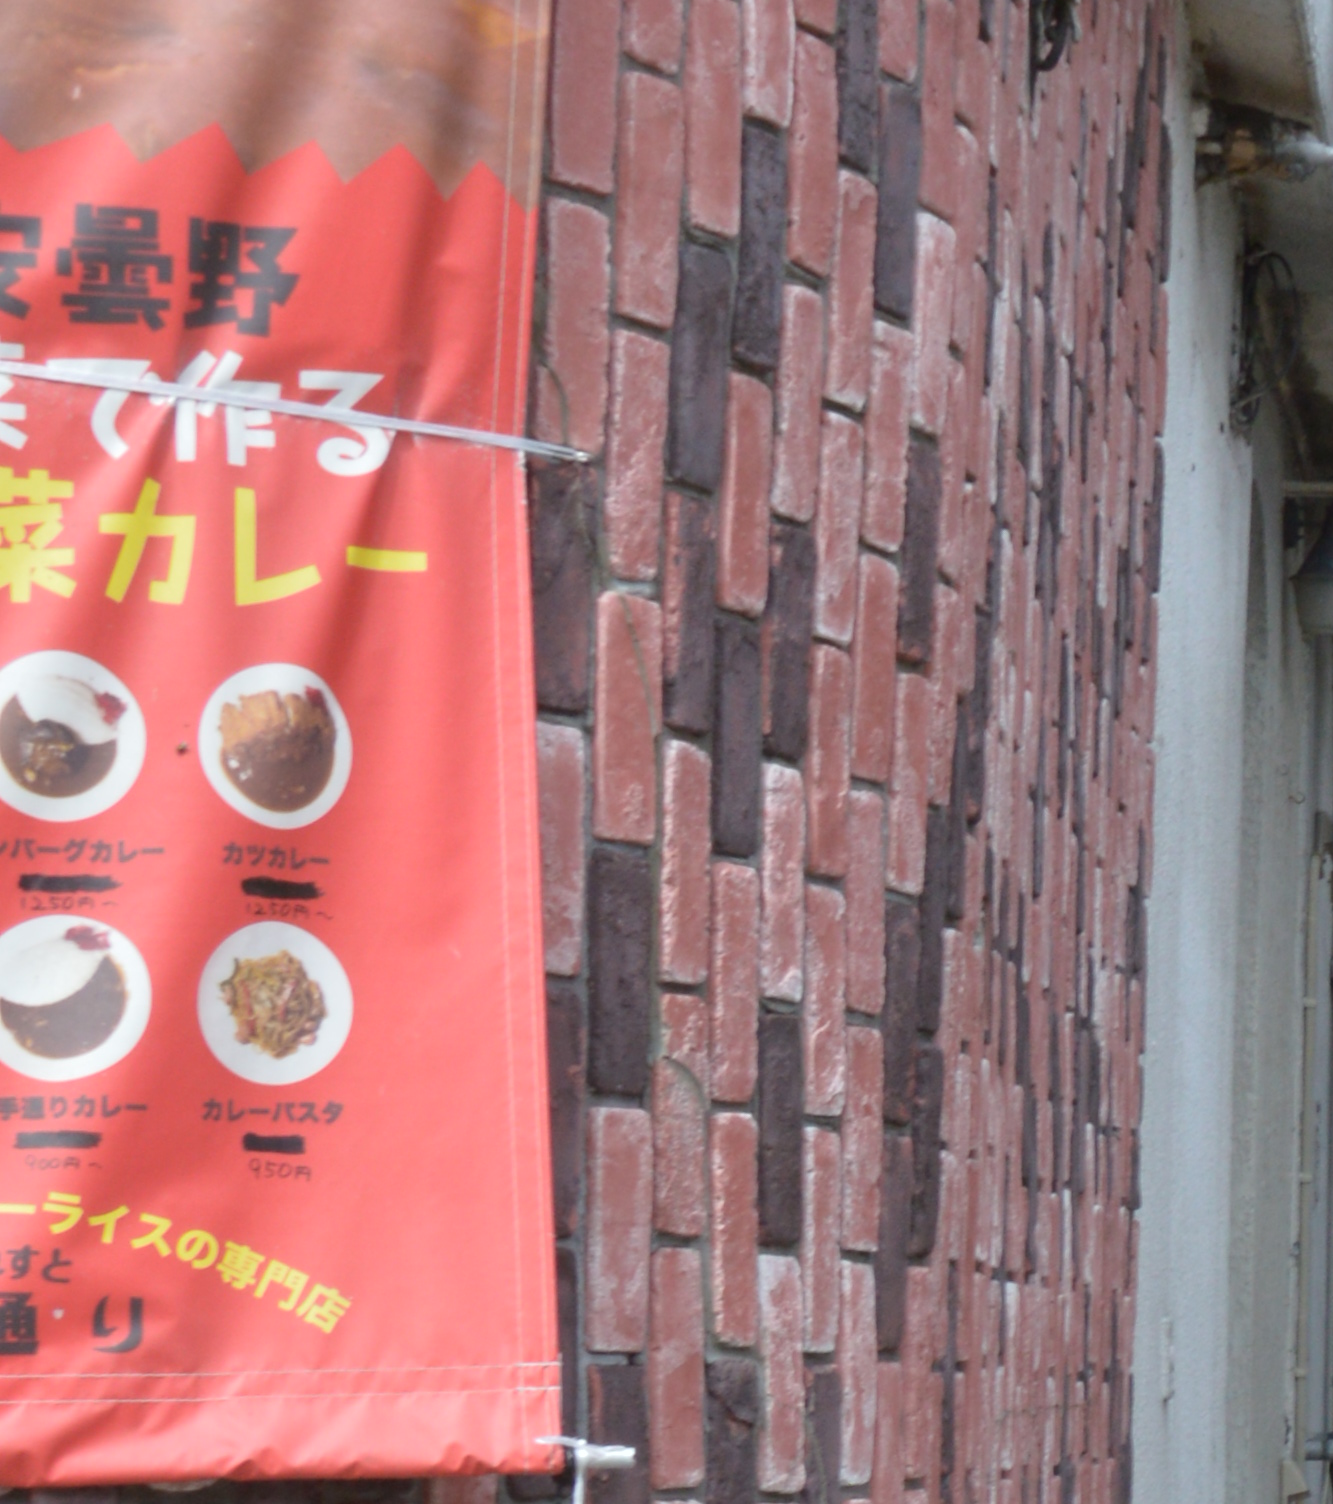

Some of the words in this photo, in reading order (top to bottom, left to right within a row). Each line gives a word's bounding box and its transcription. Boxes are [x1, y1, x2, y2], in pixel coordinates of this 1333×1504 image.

[222, 842, 329, 870] カツカレー
[202, 1098, 344, 1124] カレーパスタ
[0, 1244, 73, 1284] すと
